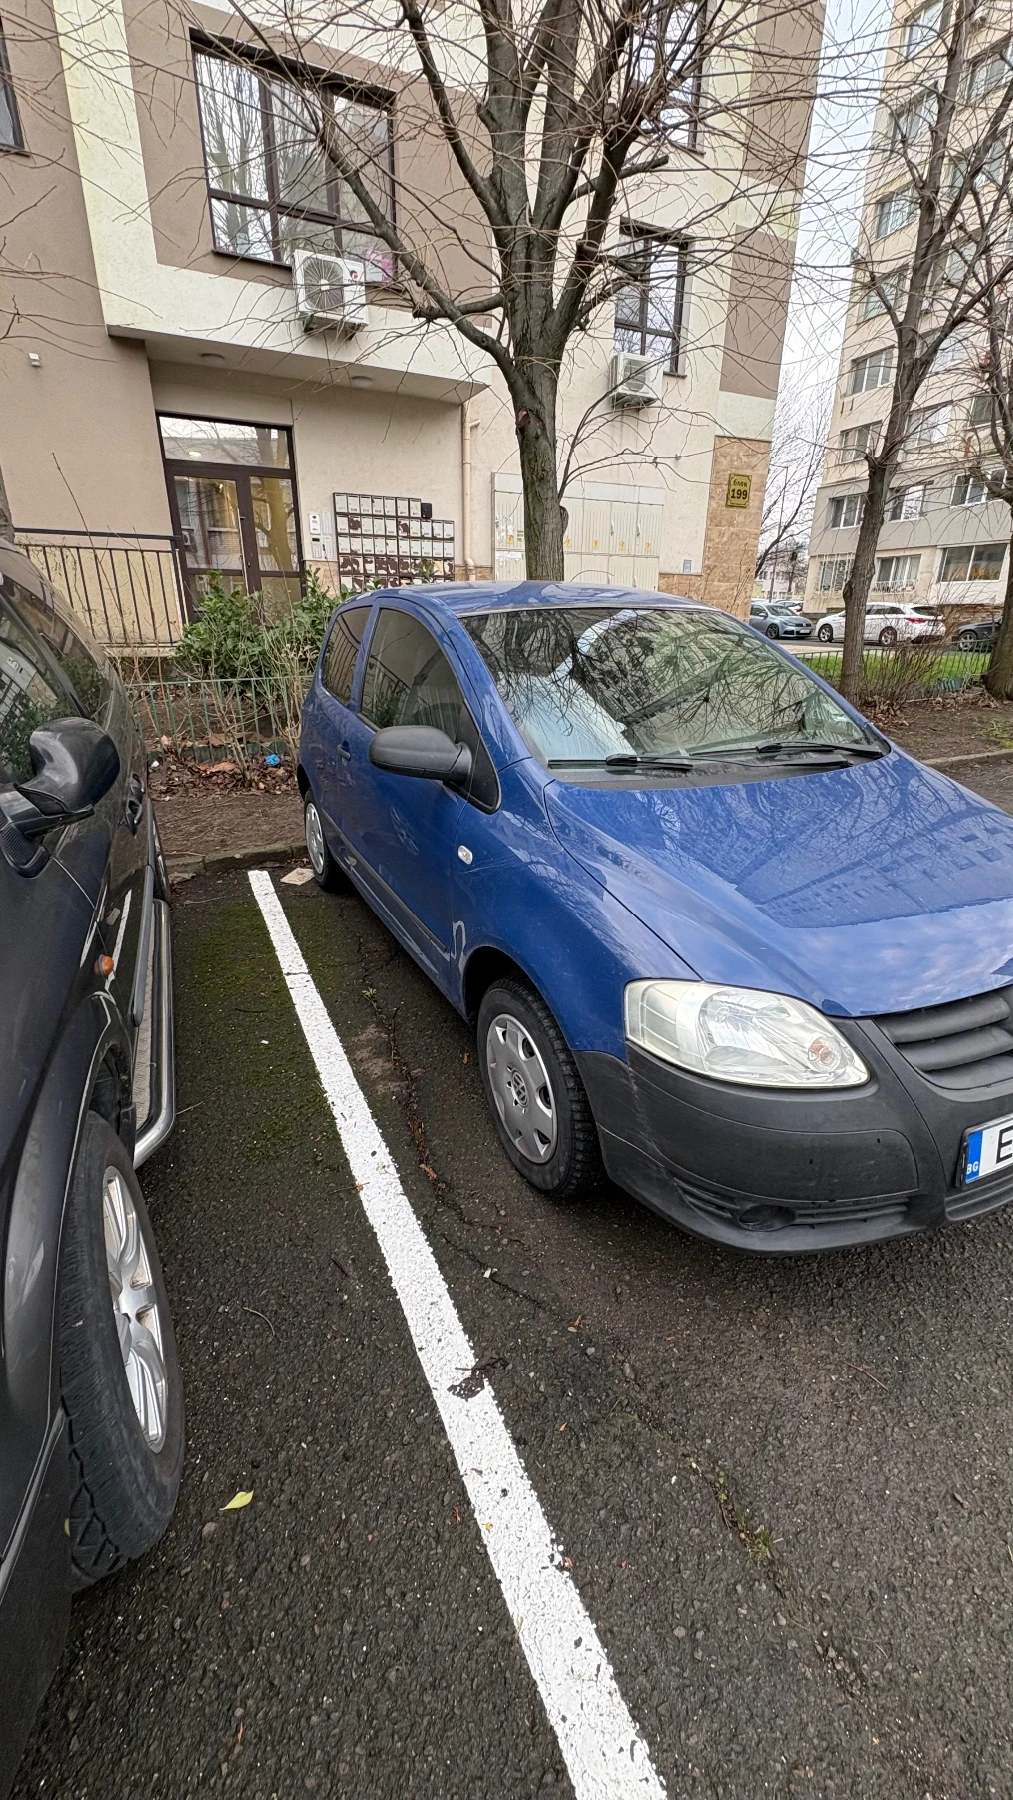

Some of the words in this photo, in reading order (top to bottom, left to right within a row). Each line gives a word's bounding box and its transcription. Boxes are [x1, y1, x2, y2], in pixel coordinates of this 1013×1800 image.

[733, 479, 748, 487] блок
[730, 488, 748, 500] 199
[966, 1161, 979, 1175] BG
